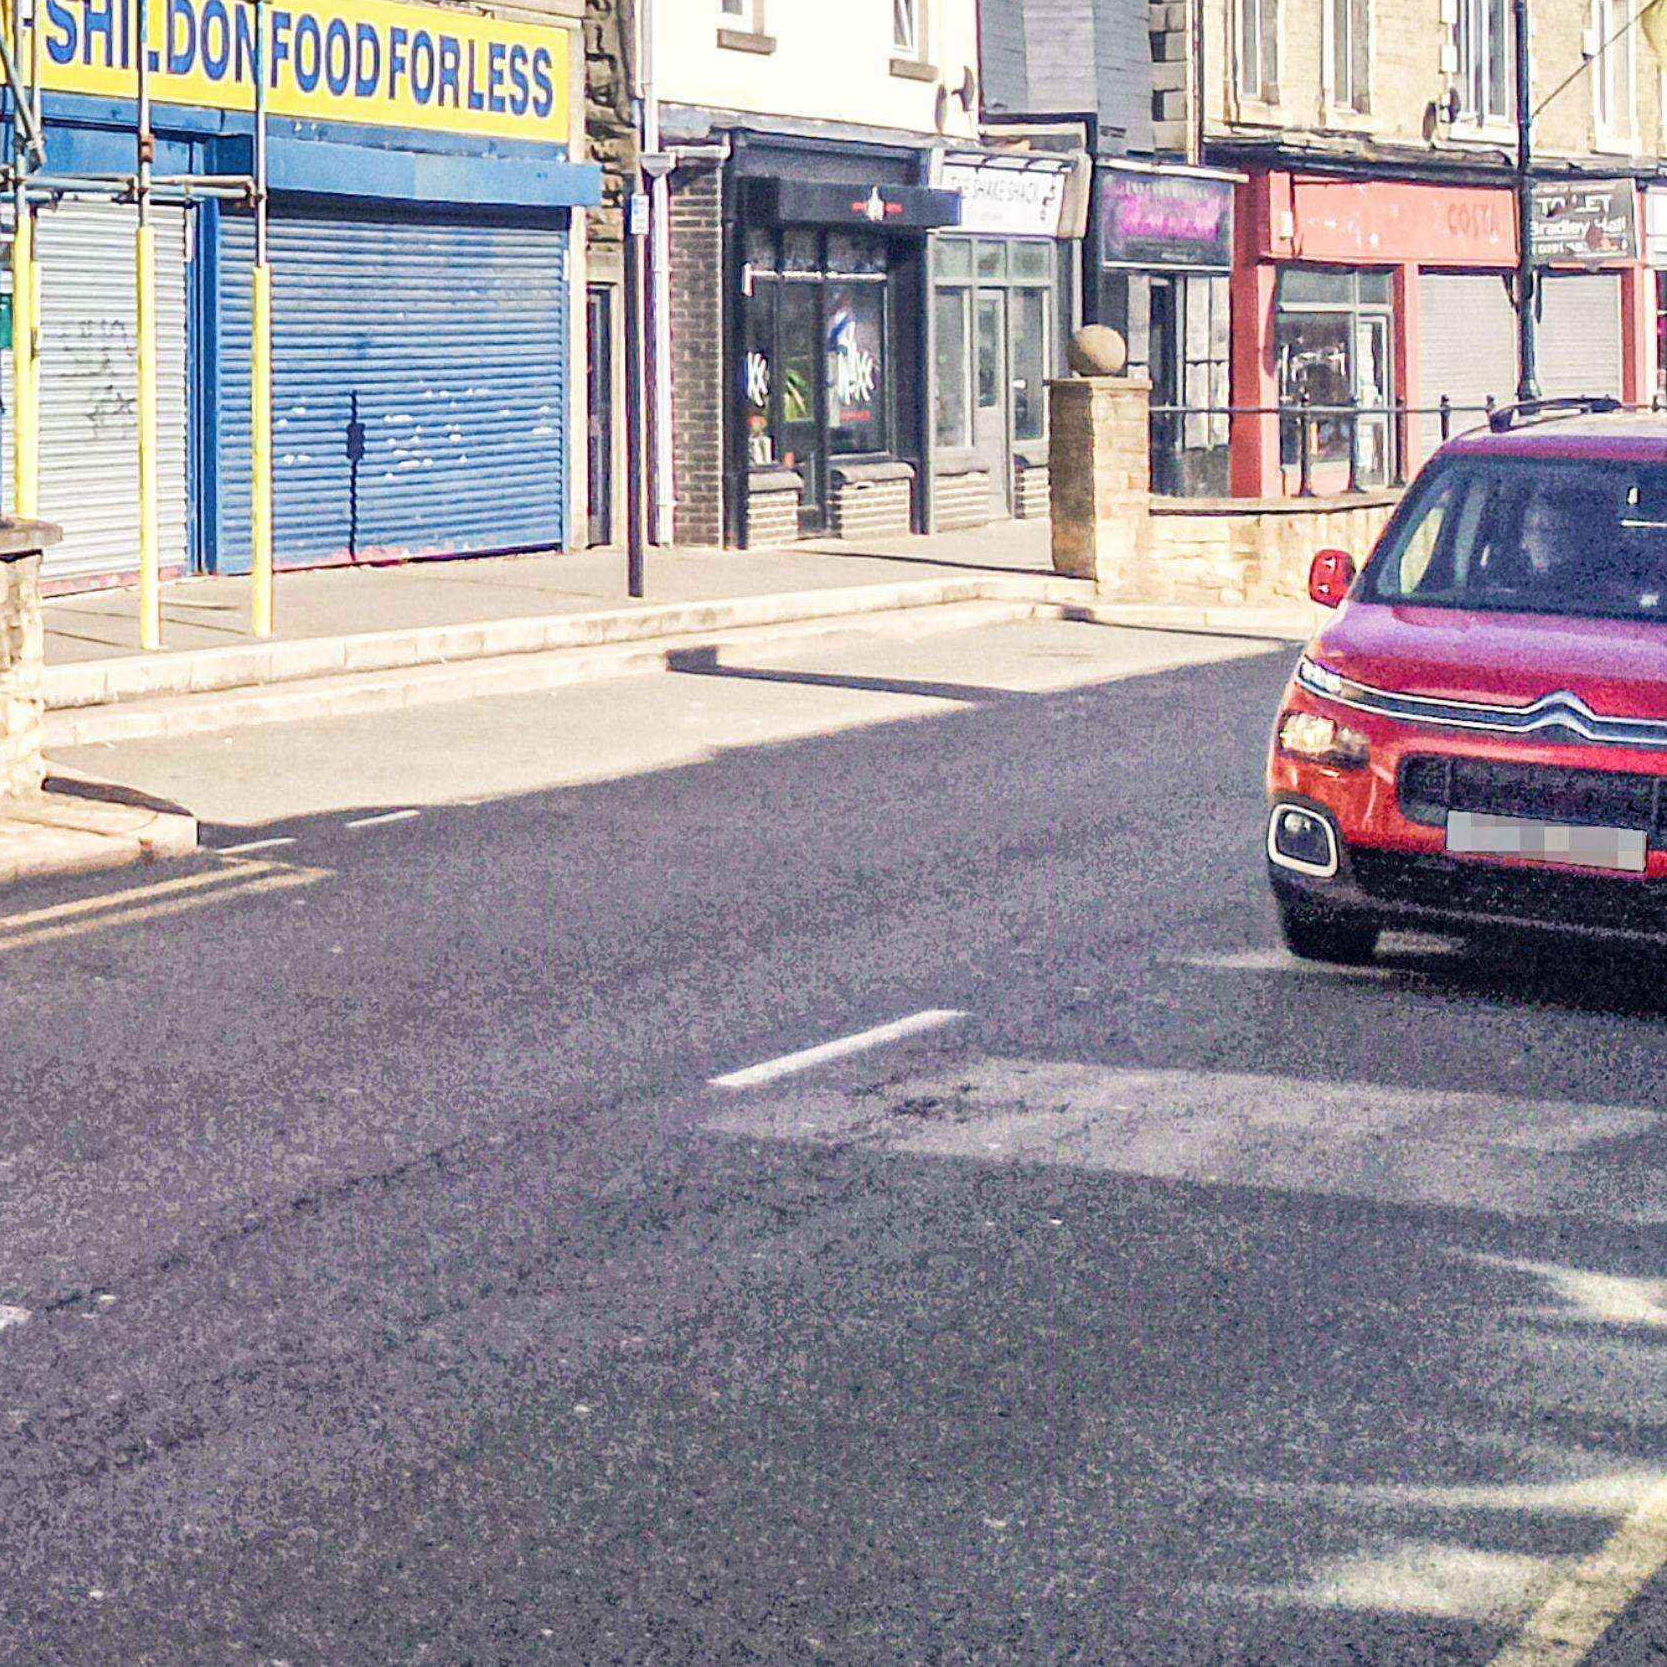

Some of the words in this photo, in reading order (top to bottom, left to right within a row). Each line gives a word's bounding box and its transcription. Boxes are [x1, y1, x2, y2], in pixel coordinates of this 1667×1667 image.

[271, 11, 381, 97] FOOD
[388, 26, 461, 109] FOR
[468, 38, 554, 119] LESS
